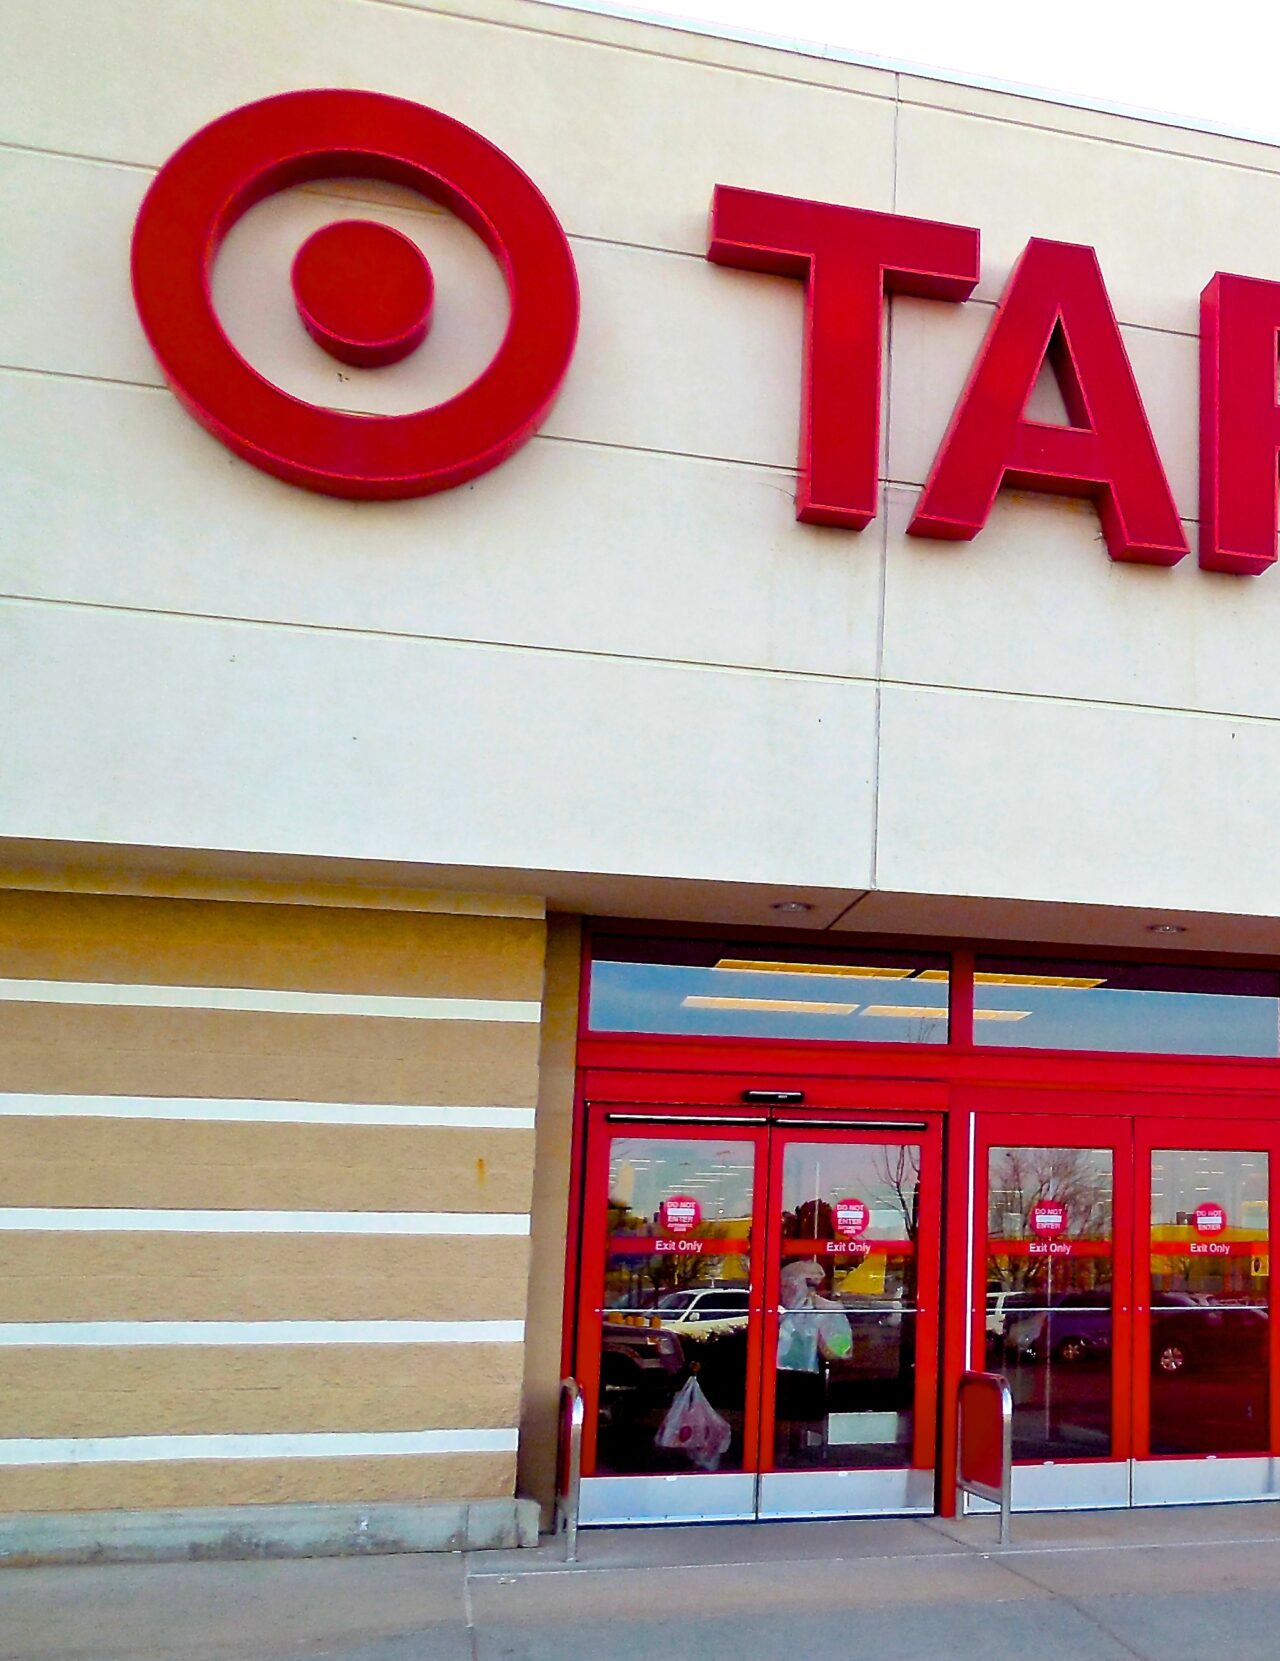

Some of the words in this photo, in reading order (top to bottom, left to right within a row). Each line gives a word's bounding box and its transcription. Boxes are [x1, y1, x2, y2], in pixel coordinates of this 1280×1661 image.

[655, 1240, 676, 1251] Exit
[678, 1240, 703, 1253] Only
[826, 1242, 846, 1252] Exit
[848, 1242, 871, 1254] Only
[1029, 1243, 1047, 1253] Exit
[1049, 1243, 1072, 1255] Only
[1190, 1243, 1208, 1253] Exit
[1209, 1243, 1231, 1254] Only
